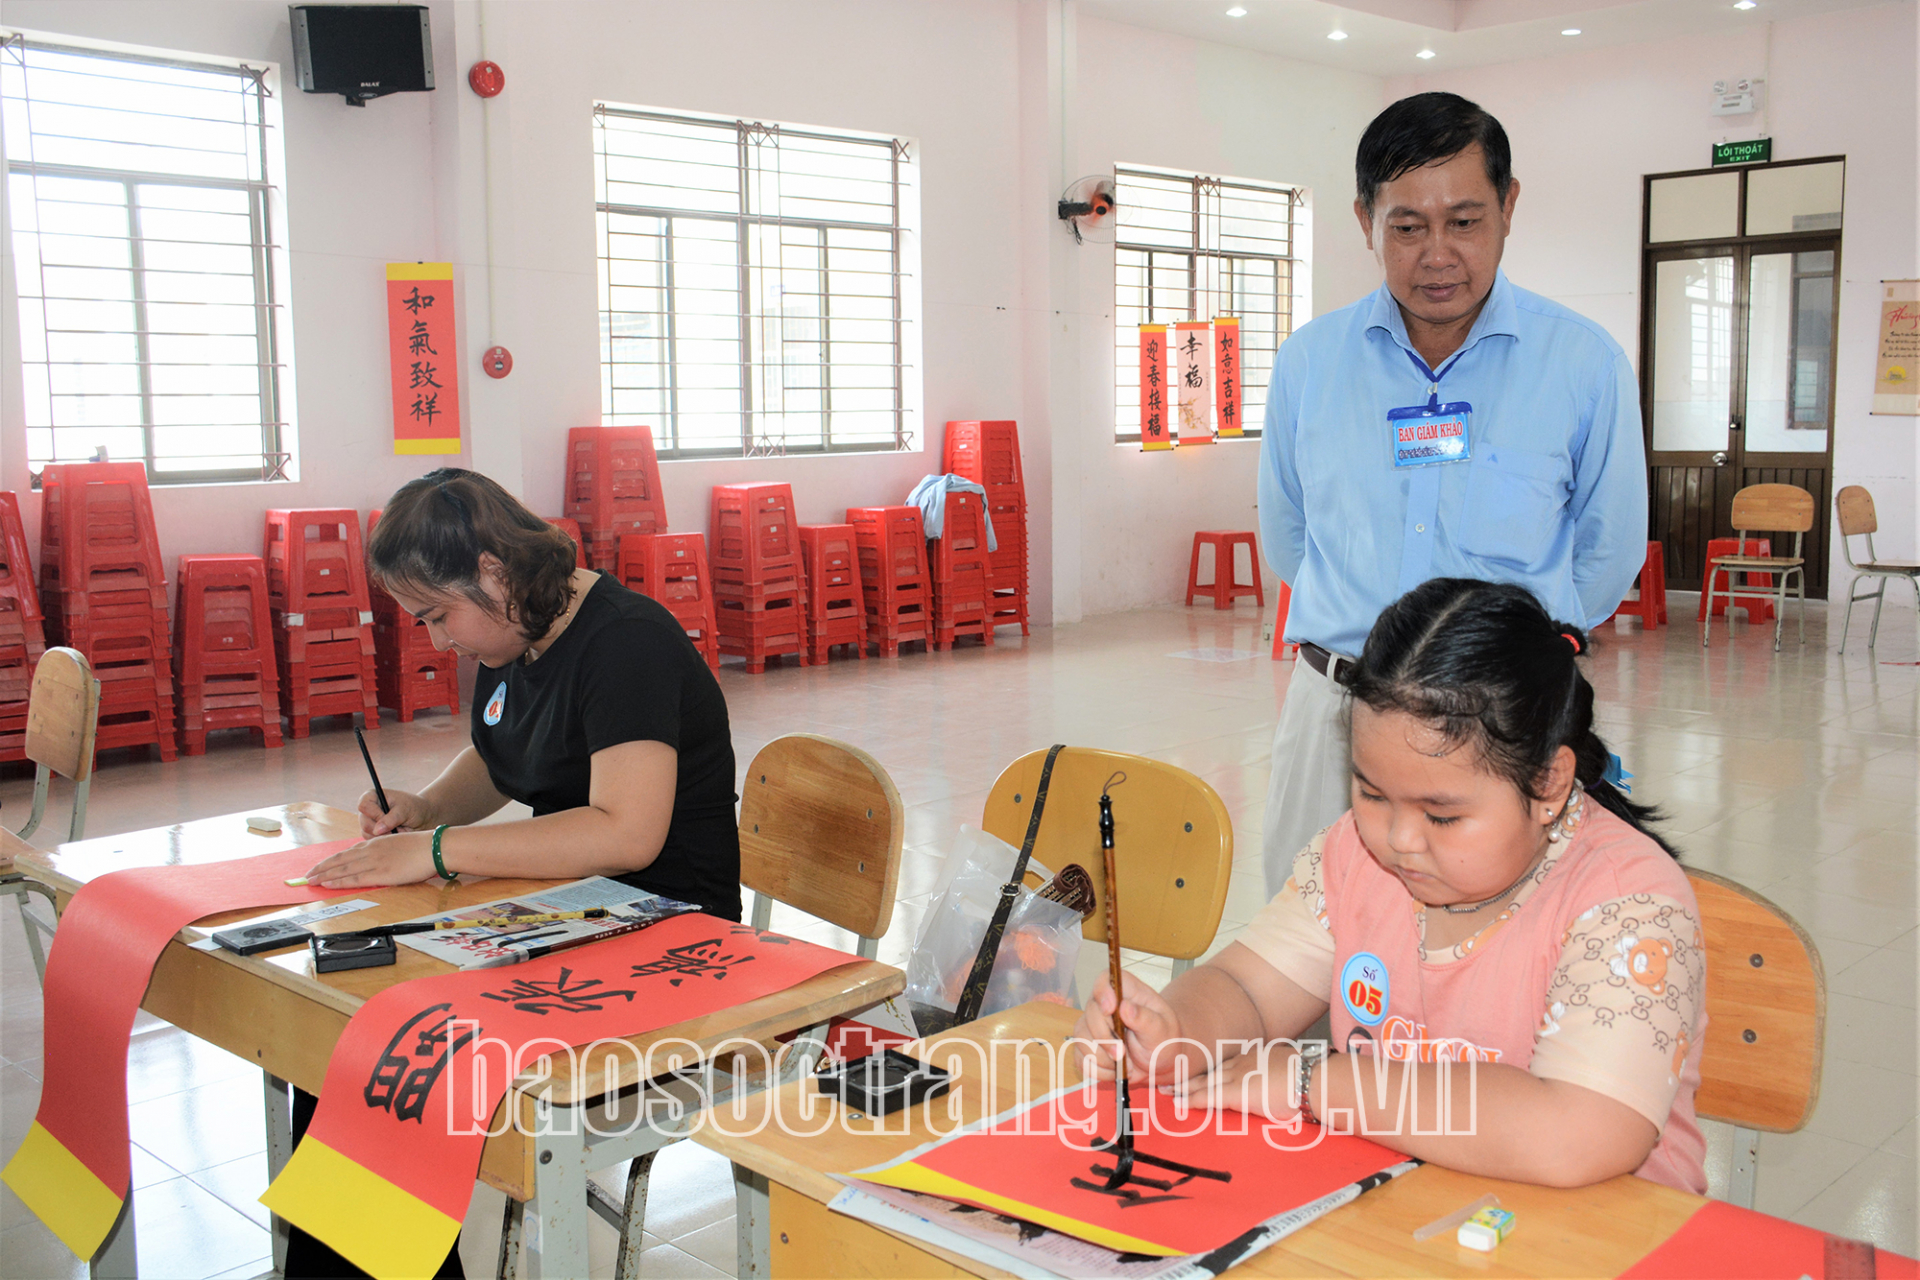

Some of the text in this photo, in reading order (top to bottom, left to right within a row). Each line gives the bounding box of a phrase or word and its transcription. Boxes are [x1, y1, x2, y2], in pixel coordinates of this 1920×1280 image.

[1734, 143, 1763, 154] THOÁT
[402, 286, 443, 427] 和氣致祥
[1180, 331, 1203, 389] 幸福
[1221, 331, 1235, 426] 如意吉祥
[1146, 339, 1161, 437] 迎春接福
[1398, 417, 1463, 442] BAN GIÁM KHẢO
[1362, 965, 1378, 981] Số
[1349, 979, 1383, 1016] 05
